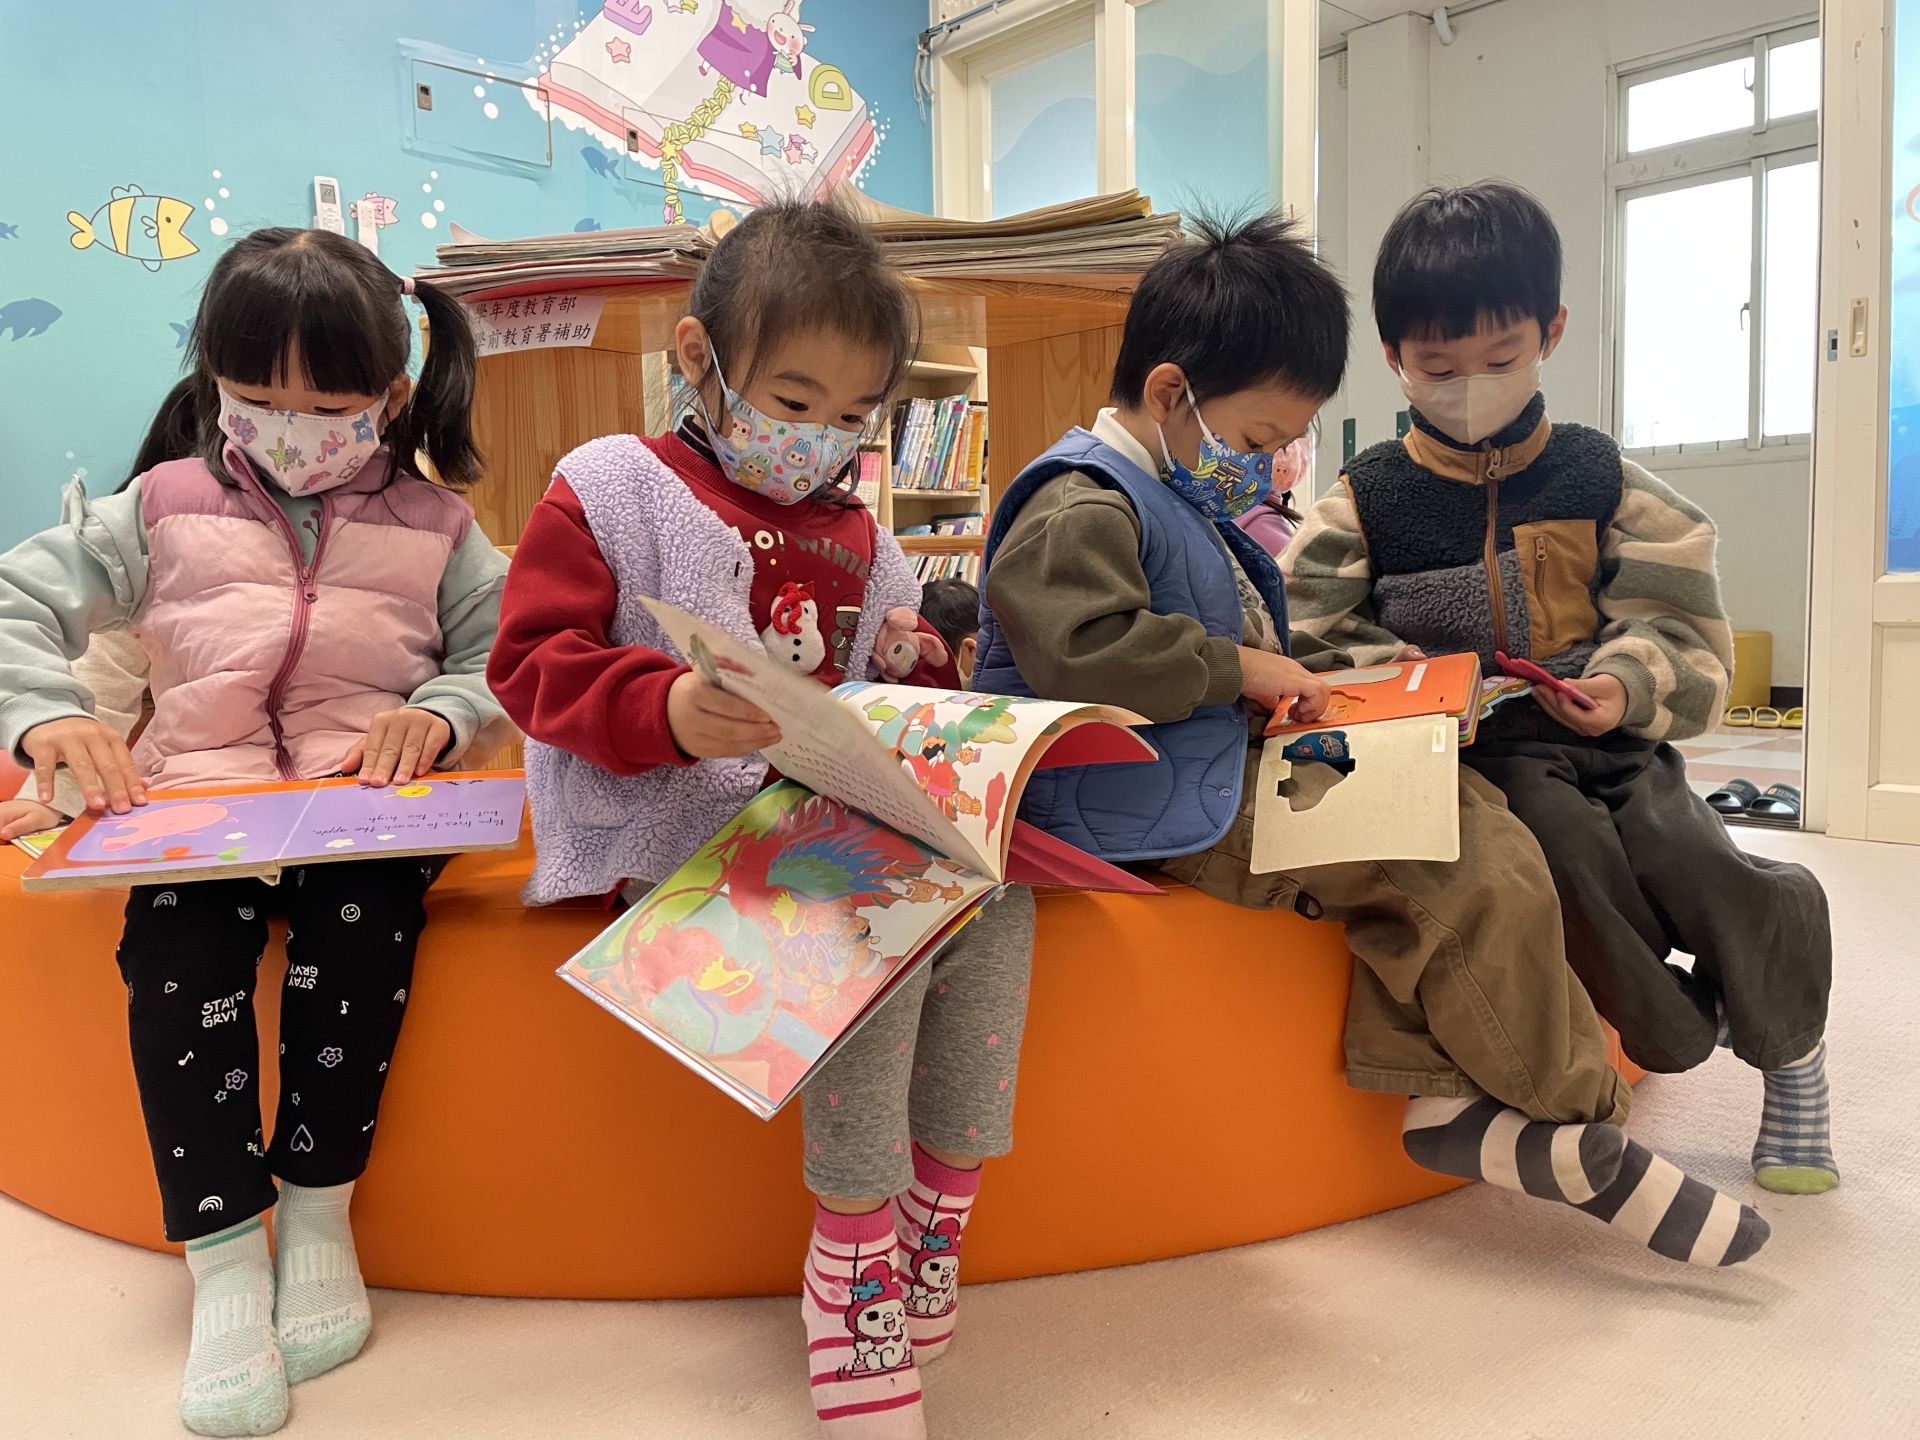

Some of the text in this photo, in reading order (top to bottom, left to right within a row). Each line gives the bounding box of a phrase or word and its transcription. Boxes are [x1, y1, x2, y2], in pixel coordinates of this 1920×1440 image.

[289, 963, 318, 978] GRVY
[288, 975, 316, 989] STAY
[201, 994, 235, 1016] STAY
[202, 1007, 238, 1028] GRVY
